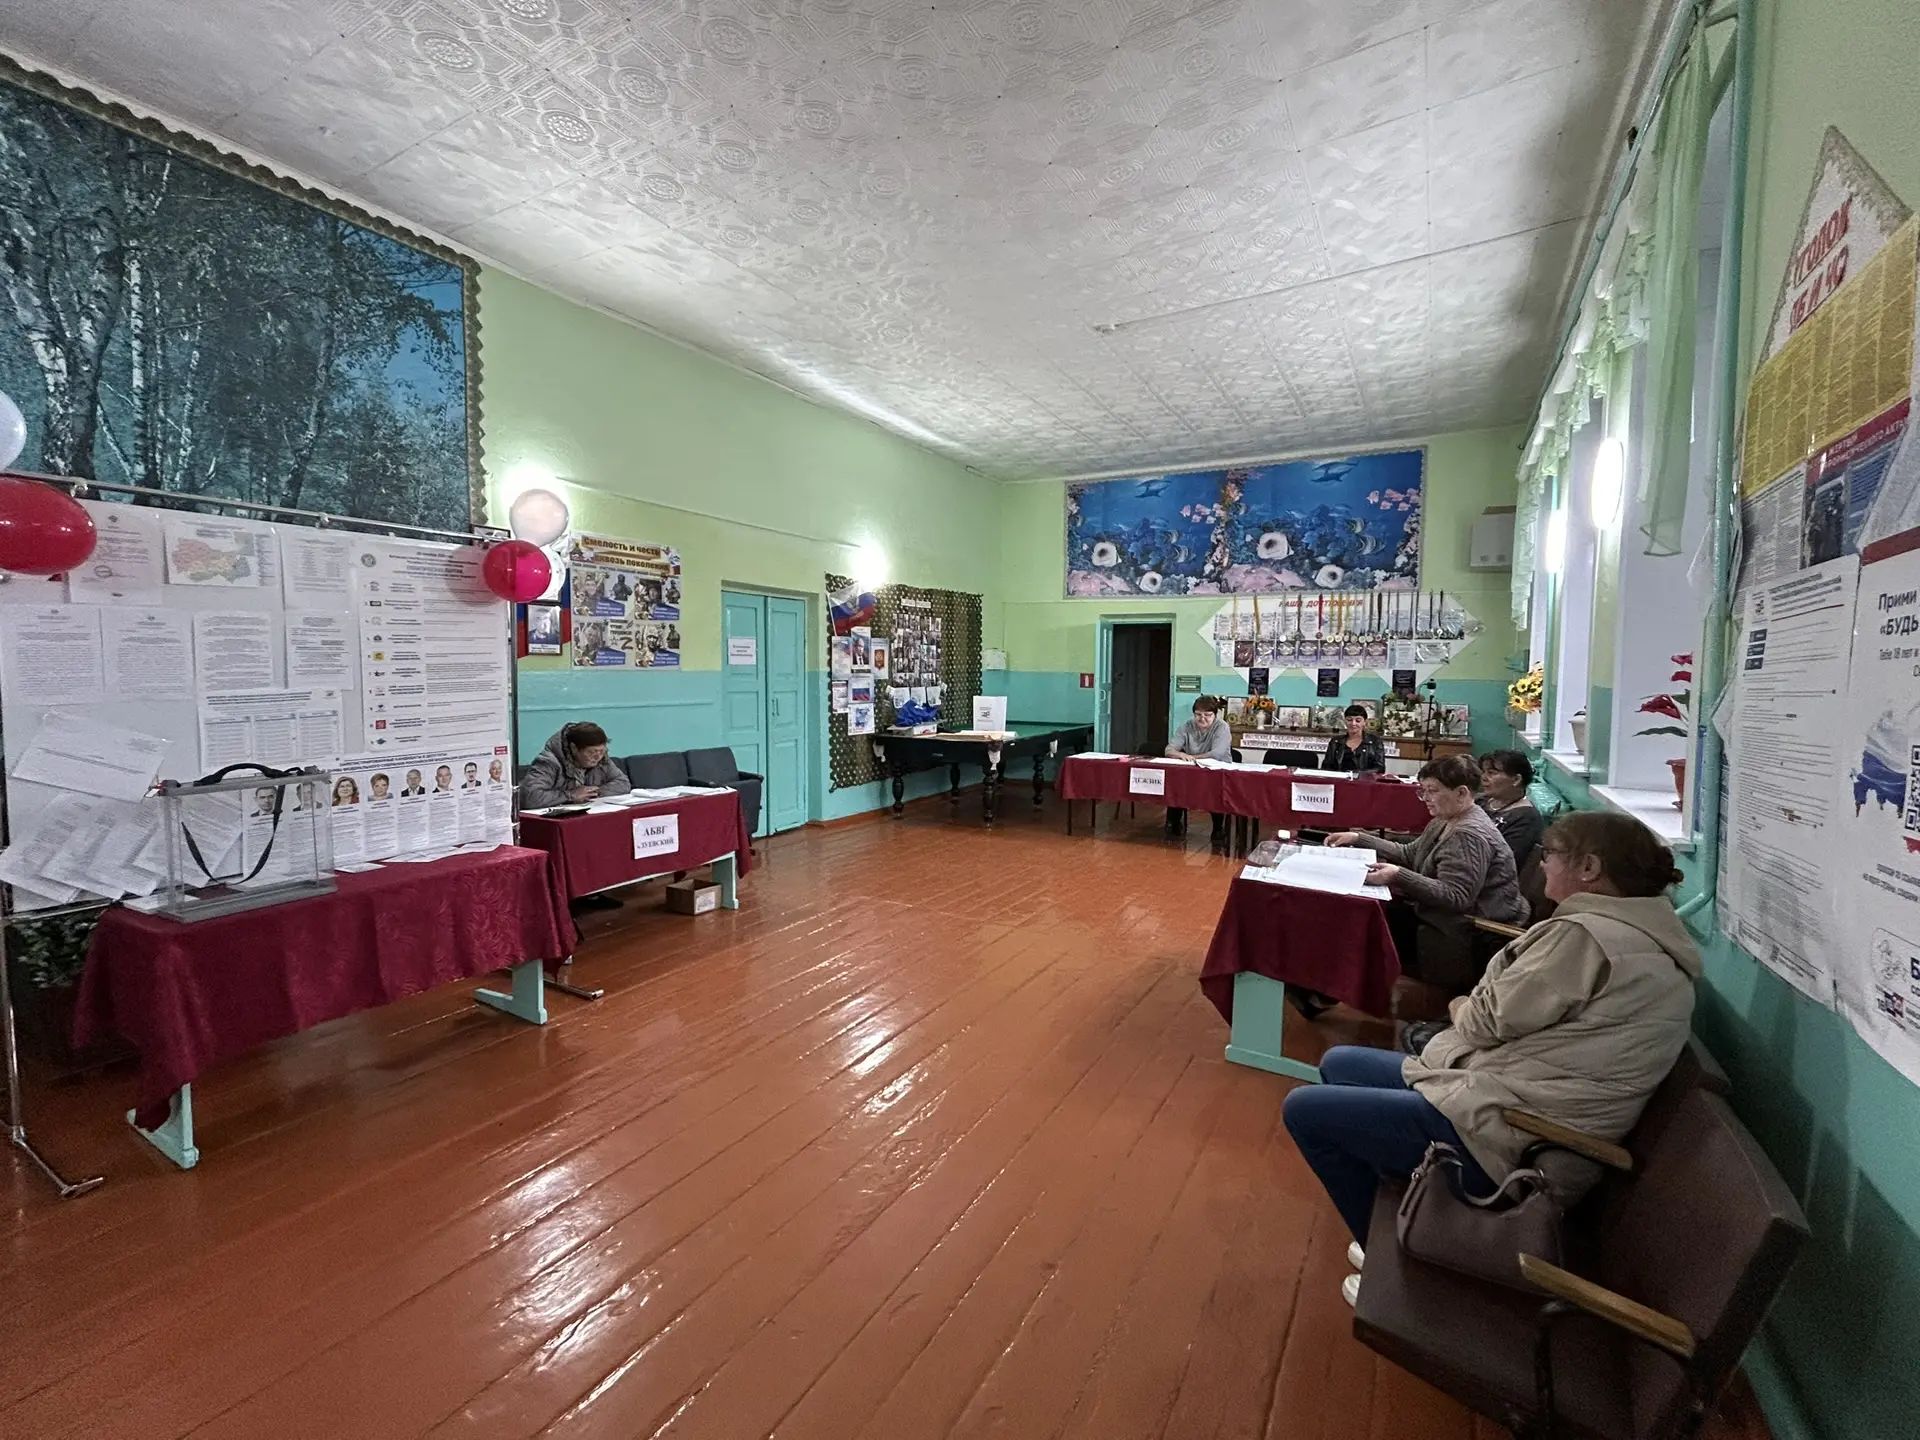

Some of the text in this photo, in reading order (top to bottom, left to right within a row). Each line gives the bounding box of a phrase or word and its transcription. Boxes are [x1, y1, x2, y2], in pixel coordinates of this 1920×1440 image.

[1878, 590, 1917, 613] Прими
[1880, 614, 1919, 636] «БУДЬ
[1295, 795, 1329, 804] ЛМНОП
[643, 825, 667, 836] АБВГ
